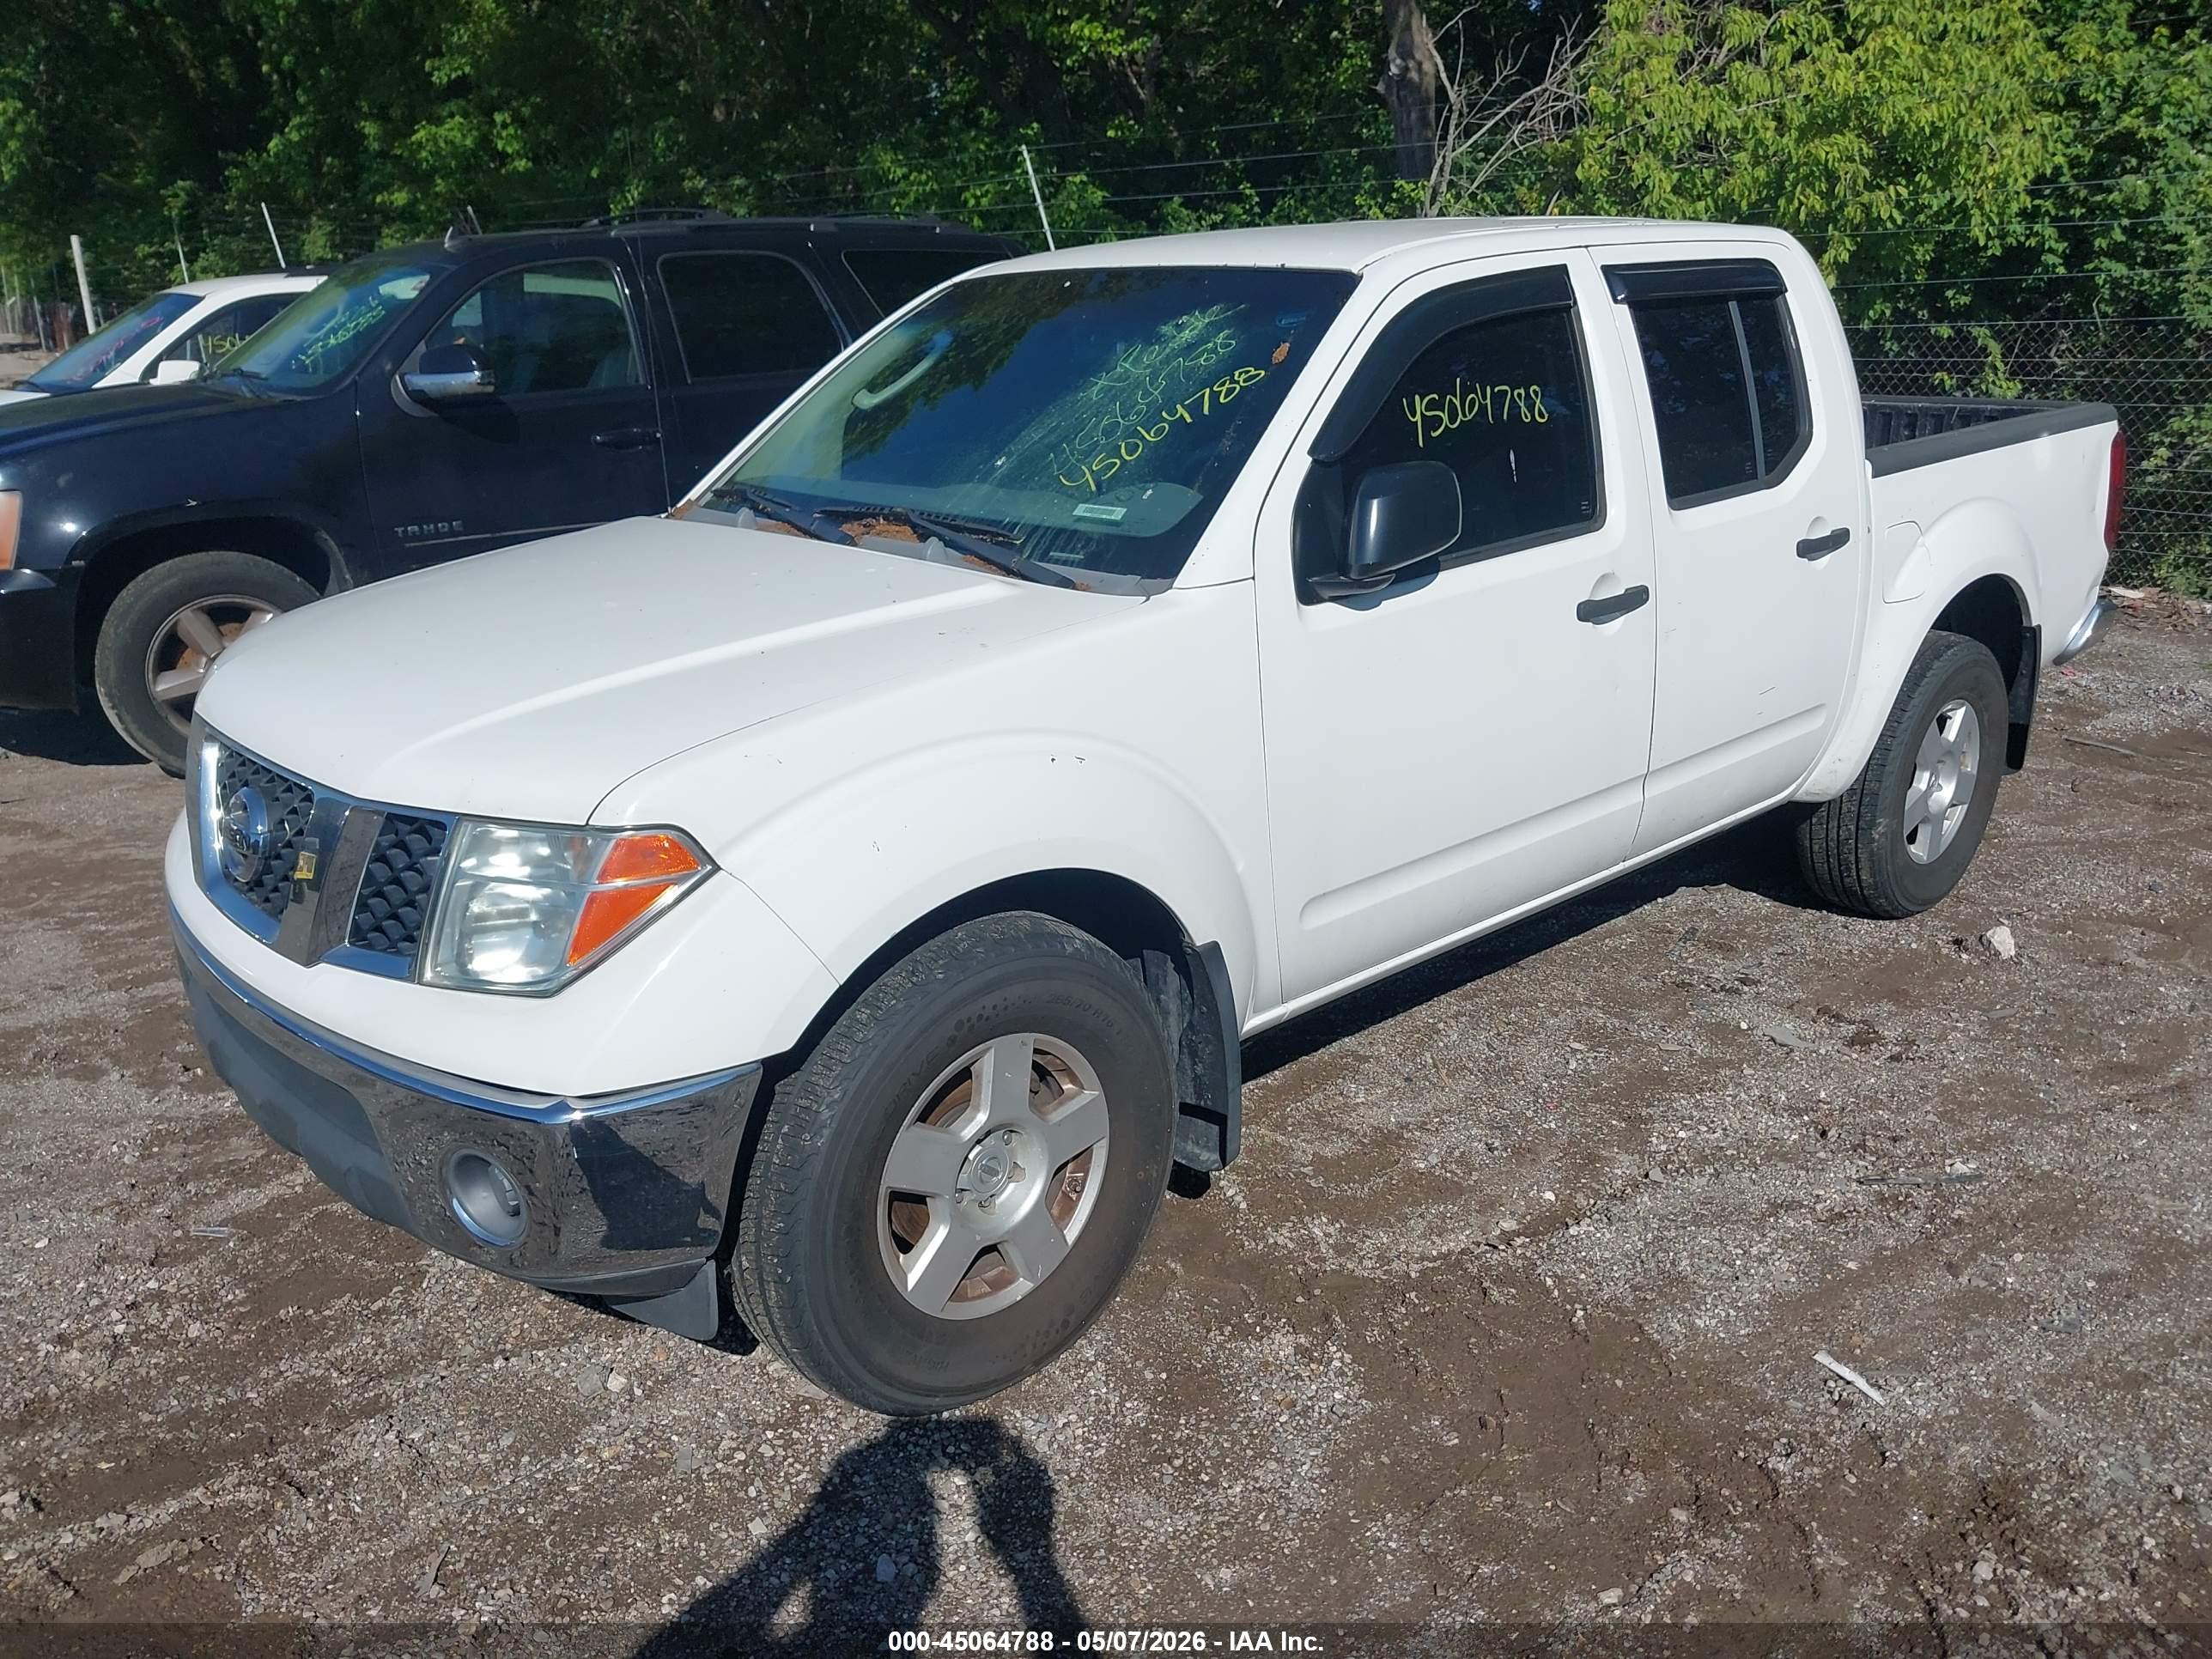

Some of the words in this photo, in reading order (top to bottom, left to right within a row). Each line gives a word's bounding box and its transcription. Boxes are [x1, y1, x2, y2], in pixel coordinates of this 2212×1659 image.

[1060, 366, 1266, 492] 45064788
[1402, 377, 1549, 448] 45064788
[393, 520, 464, 538] TAHOE
